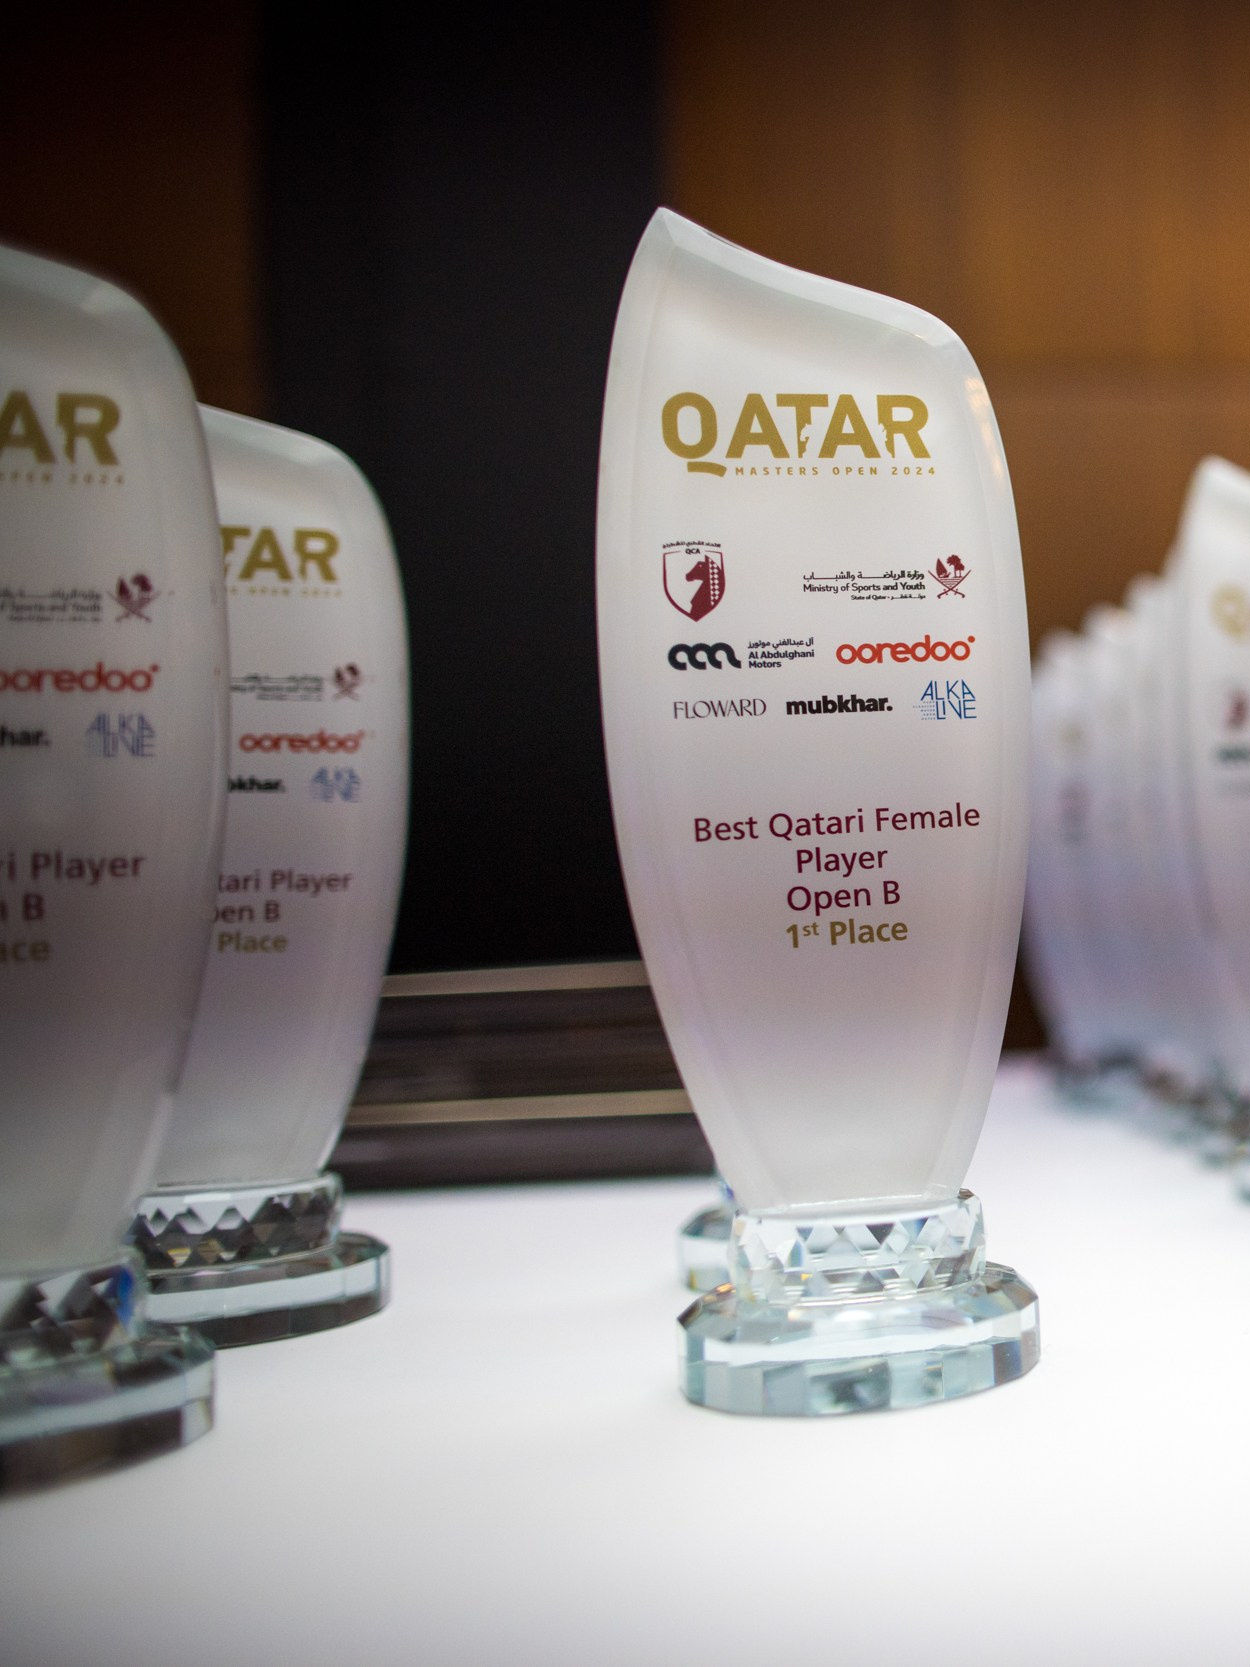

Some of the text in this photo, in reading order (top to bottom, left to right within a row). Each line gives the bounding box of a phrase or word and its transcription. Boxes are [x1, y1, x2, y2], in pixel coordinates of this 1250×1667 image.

[661, 391, 931, 477] QATAR
[735, 466, 936, 476] MASTERS OPEN 2024
[803, 570, 925, 582] وزارة الرياضة والشباب
[803, 582, 926, 594] Ministry of Sports and Youth
[748, 649, 815, 661] Al Abdulghani
[836, 634, 975, 665] ooredoo
[748, 660, 782, 669] Motors
[673, 698, 767, 720] FLOWARD
[786, 694, 893, 715] mubkhar.
[694, 802, 980, 842] Best Qatari Female
[31, 850, 147, 886] Player
[796, 847, 888, 878] Player
[270, 869, 352, 898] Player
[786, 880, 901, 916] Open B
[22, 892, 45, 921] B
[264, 899, 281, 922] B
[785, 918, 909, 949] 1st Place
